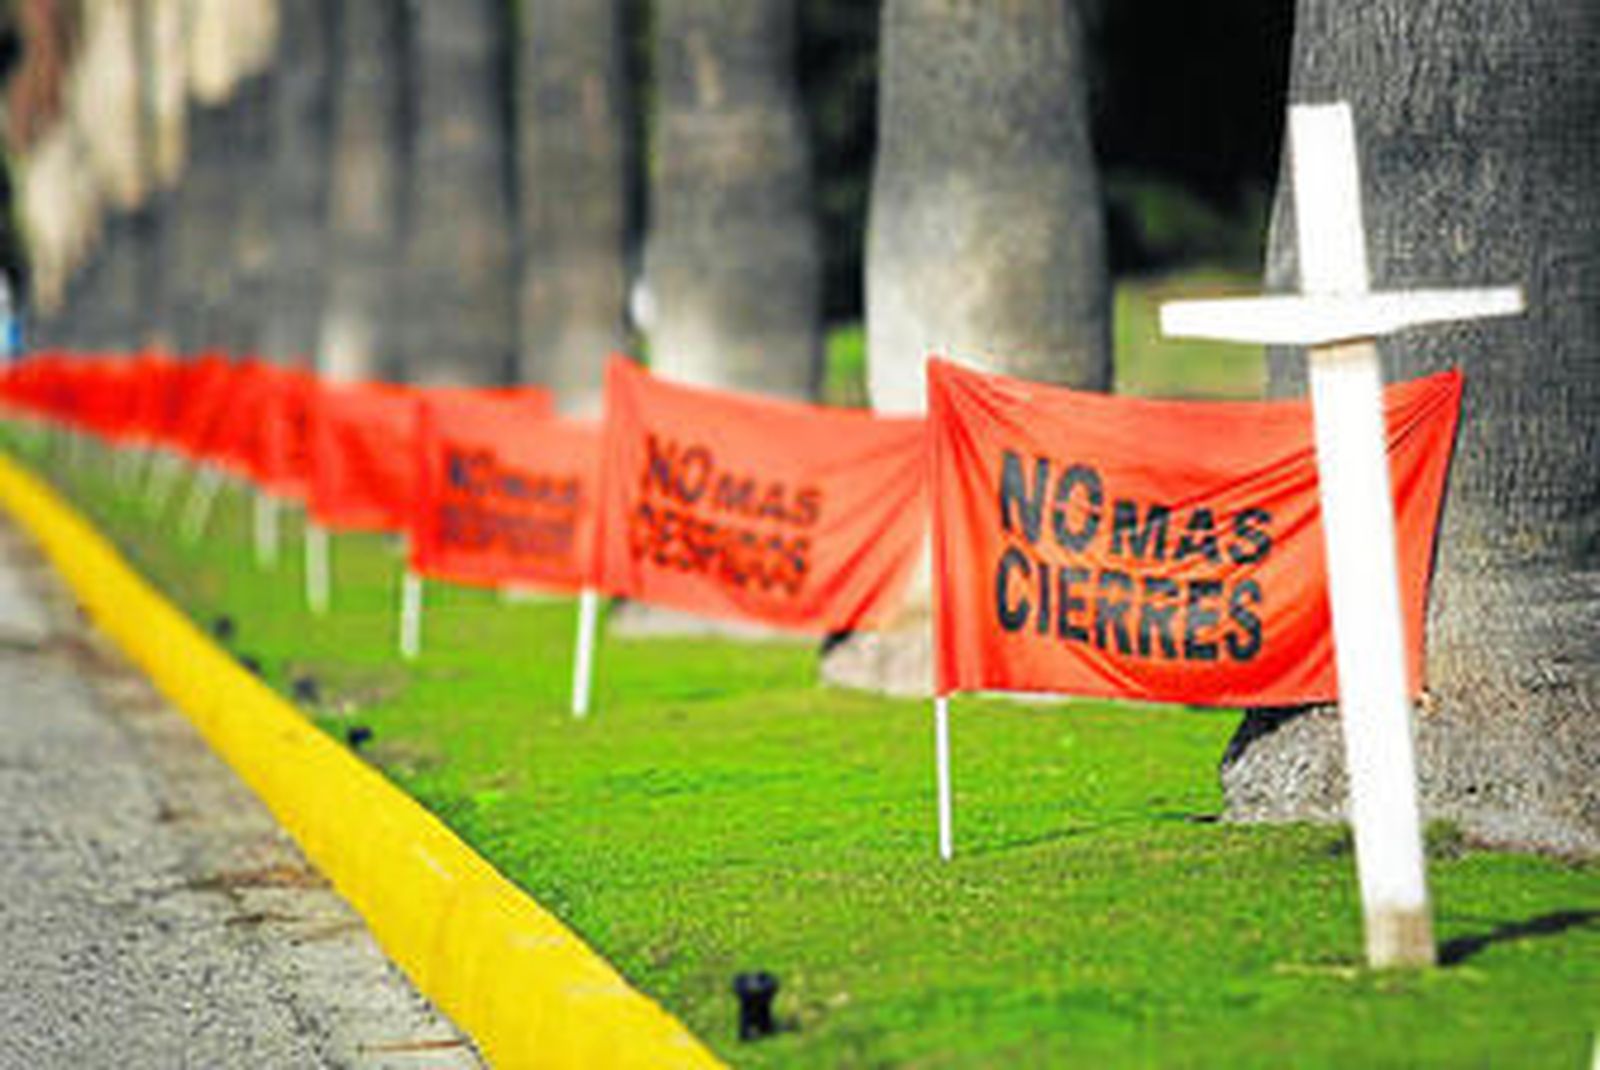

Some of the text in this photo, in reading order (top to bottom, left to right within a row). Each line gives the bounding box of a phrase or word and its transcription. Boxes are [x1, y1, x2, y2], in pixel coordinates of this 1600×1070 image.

[640, 433, 822, 528] NO MAS
[1000, 450, 1274, 566] NO MAS
[996, 547, 1263, 662] CIERRES
